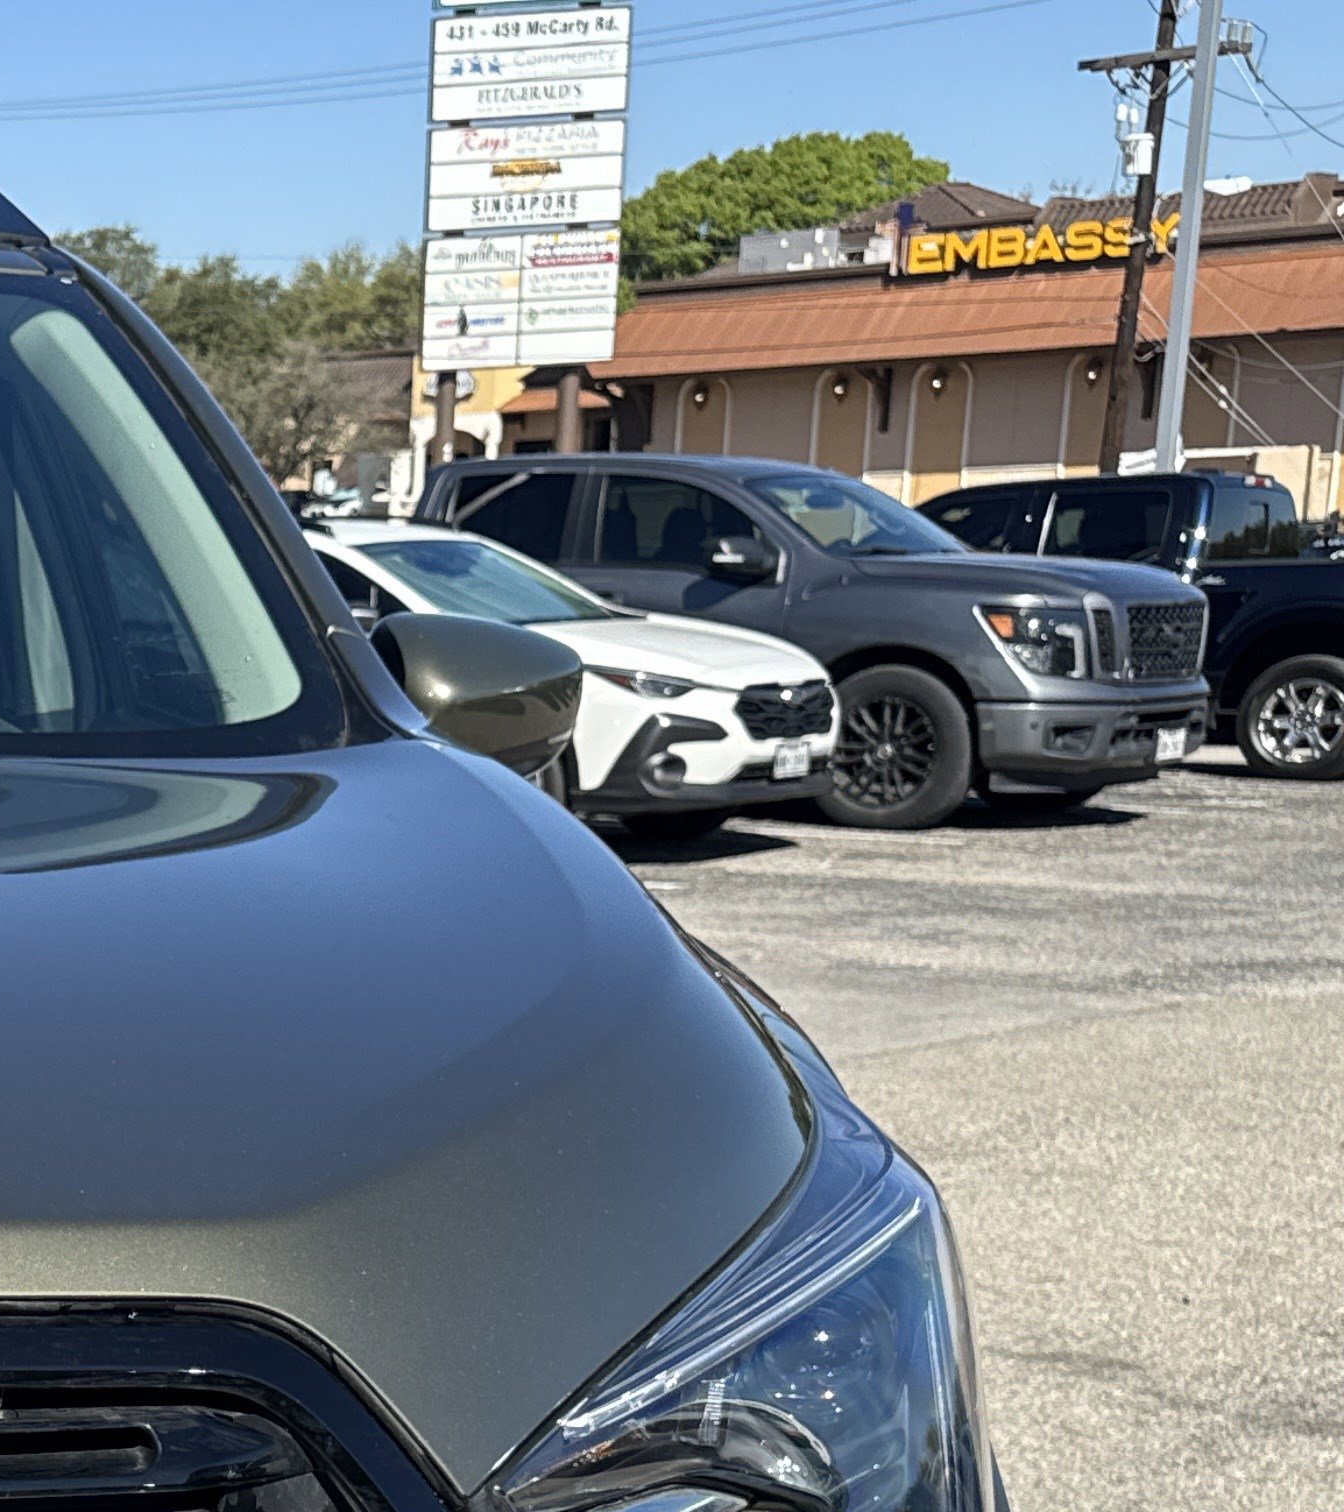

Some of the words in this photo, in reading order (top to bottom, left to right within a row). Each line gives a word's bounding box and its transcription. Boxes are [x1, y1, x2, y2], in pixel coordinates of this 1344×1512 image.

[526, 18, 590, 36] McCarty
[471, 193, 579, 216] SINGAPORE
[909, 212, 1181, 275] EMBASSY
